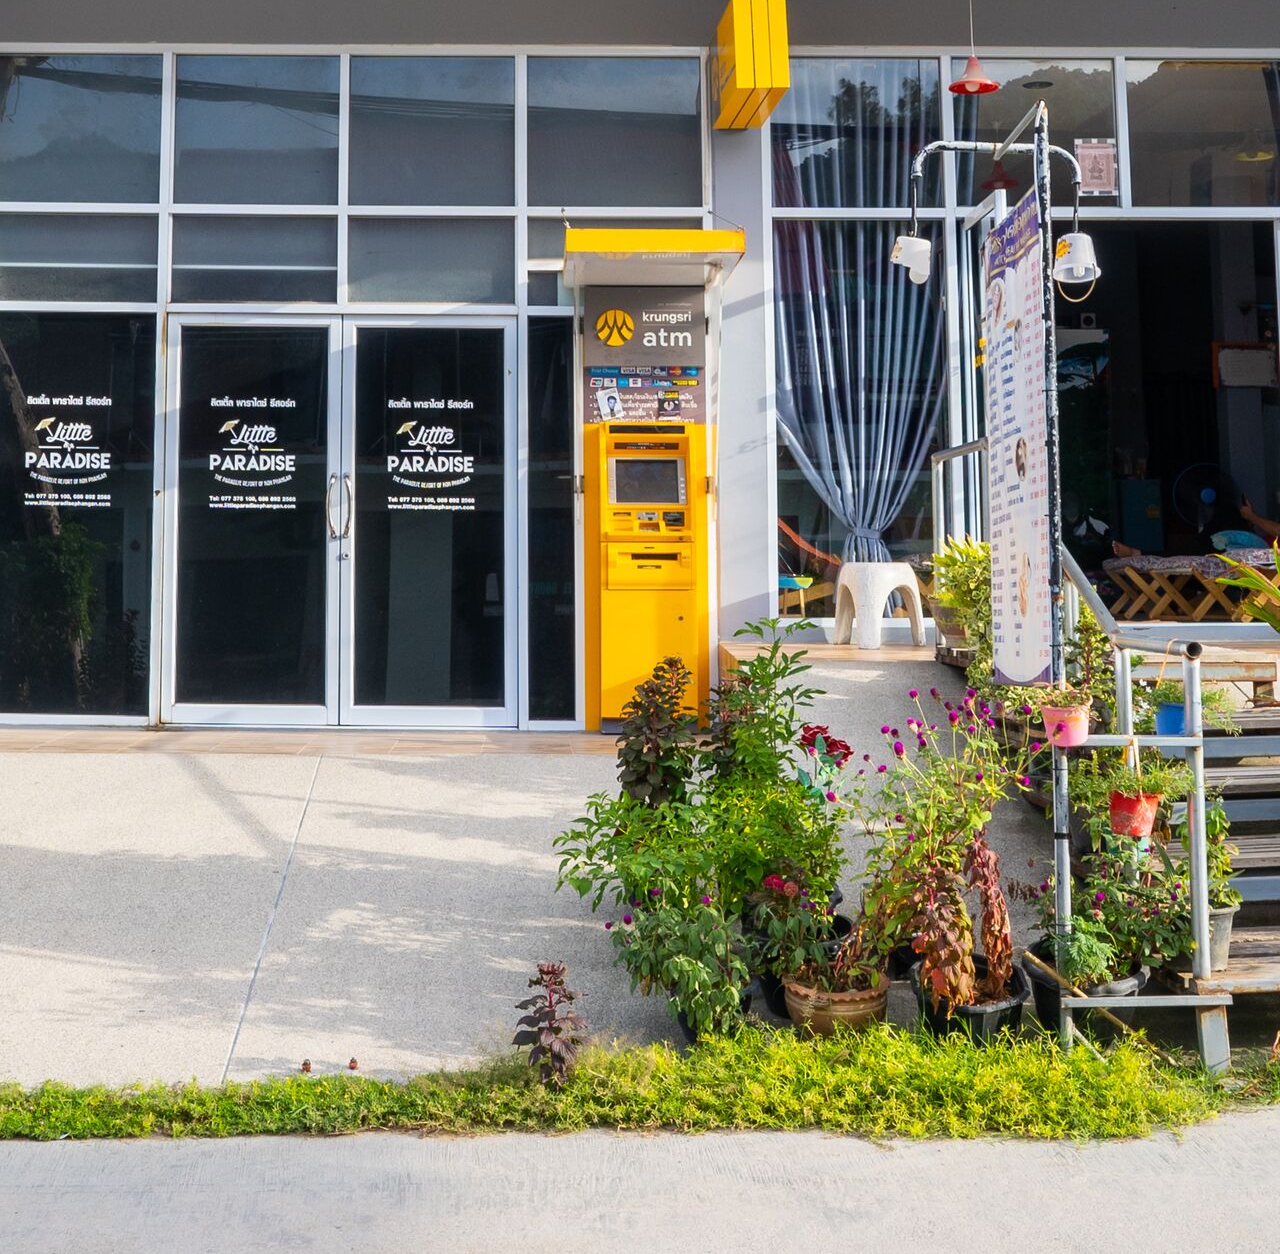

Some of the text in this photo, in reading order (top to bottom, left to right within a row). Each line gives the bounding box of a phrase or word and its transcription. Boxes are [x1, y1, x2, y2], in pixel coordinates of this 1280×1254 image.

[642, 311, 692, 324] krungsri
[642, 328, 692, 347] atm
[46, 422, 93, 443] Little
[230, 424, 277, 445] Little
[408, 426, 455, 446] Little
[25, 452, 111, 469] PARADISE
[209, 454, 296, 471] PARADISE
[387, 456, 474, 473] PARADISE
